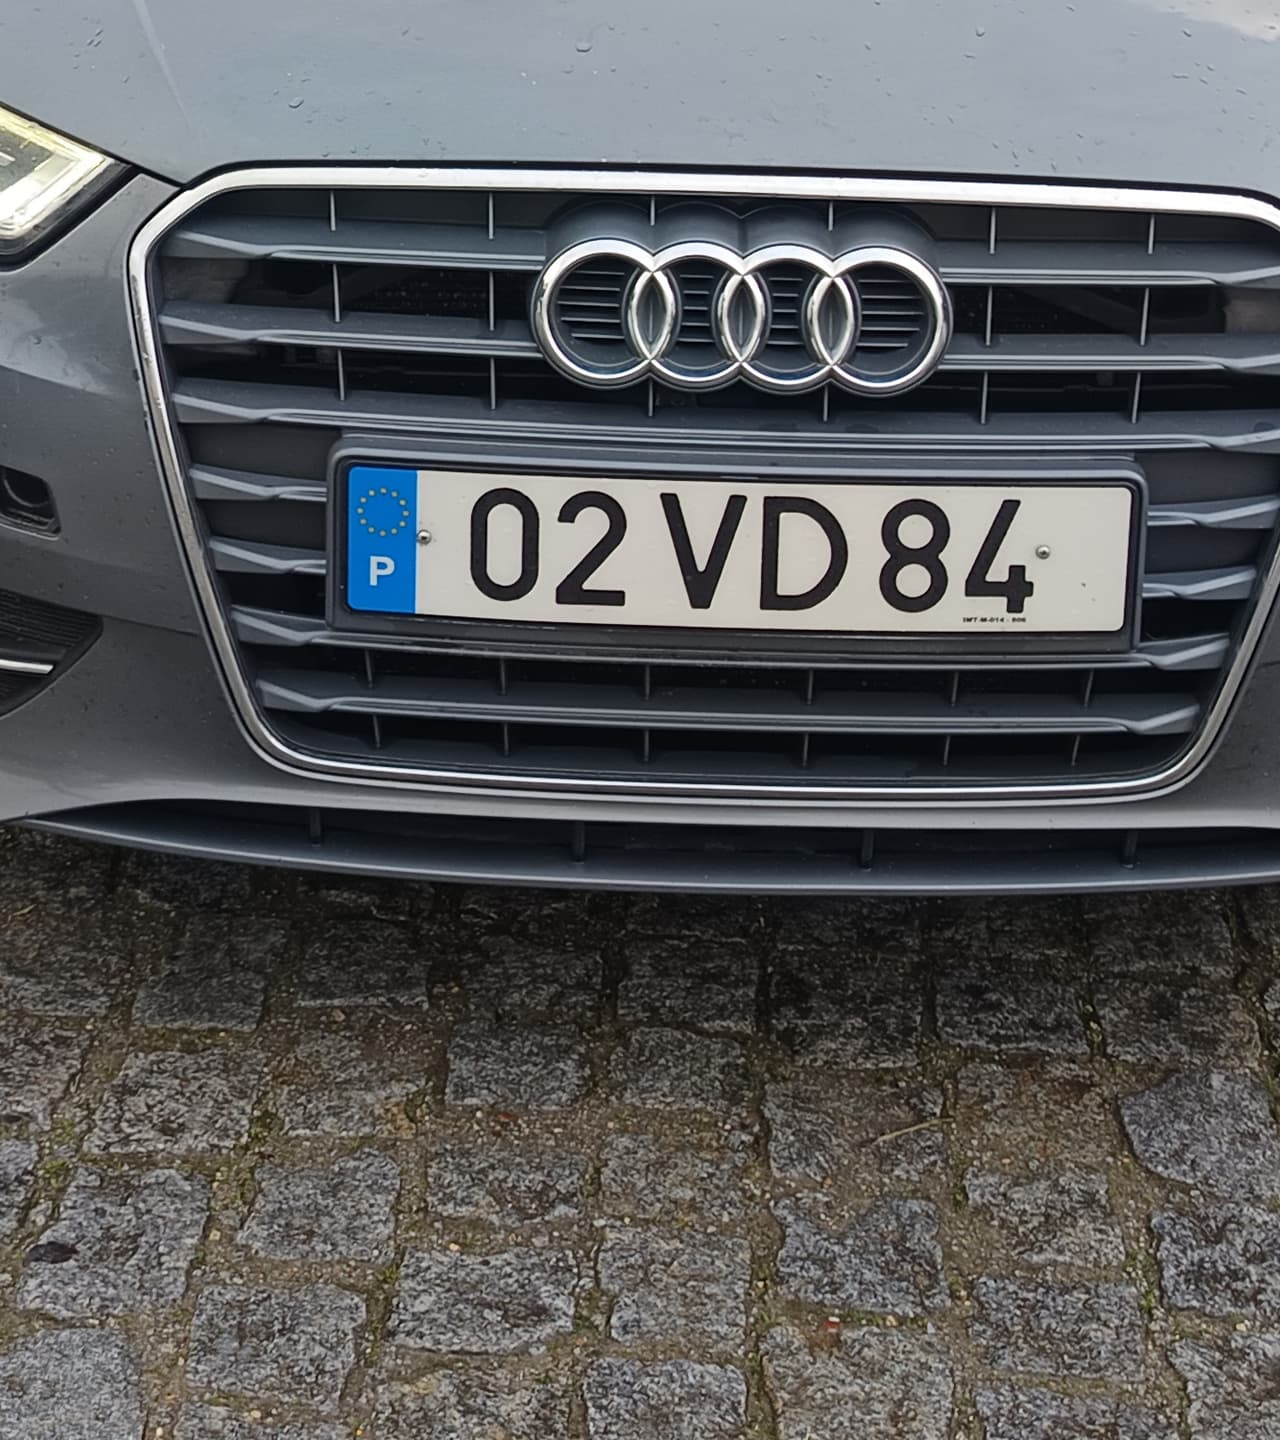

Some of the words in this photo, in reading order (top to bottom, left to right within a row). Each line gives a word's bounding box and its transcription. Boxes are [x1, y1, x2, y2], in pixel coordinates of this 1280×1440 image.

[369, 556, 395, 586] P
[469, 486, 627, 606] 02
[659, 492, 849, 611] VD
[878, 497, 1034, 614] 84
